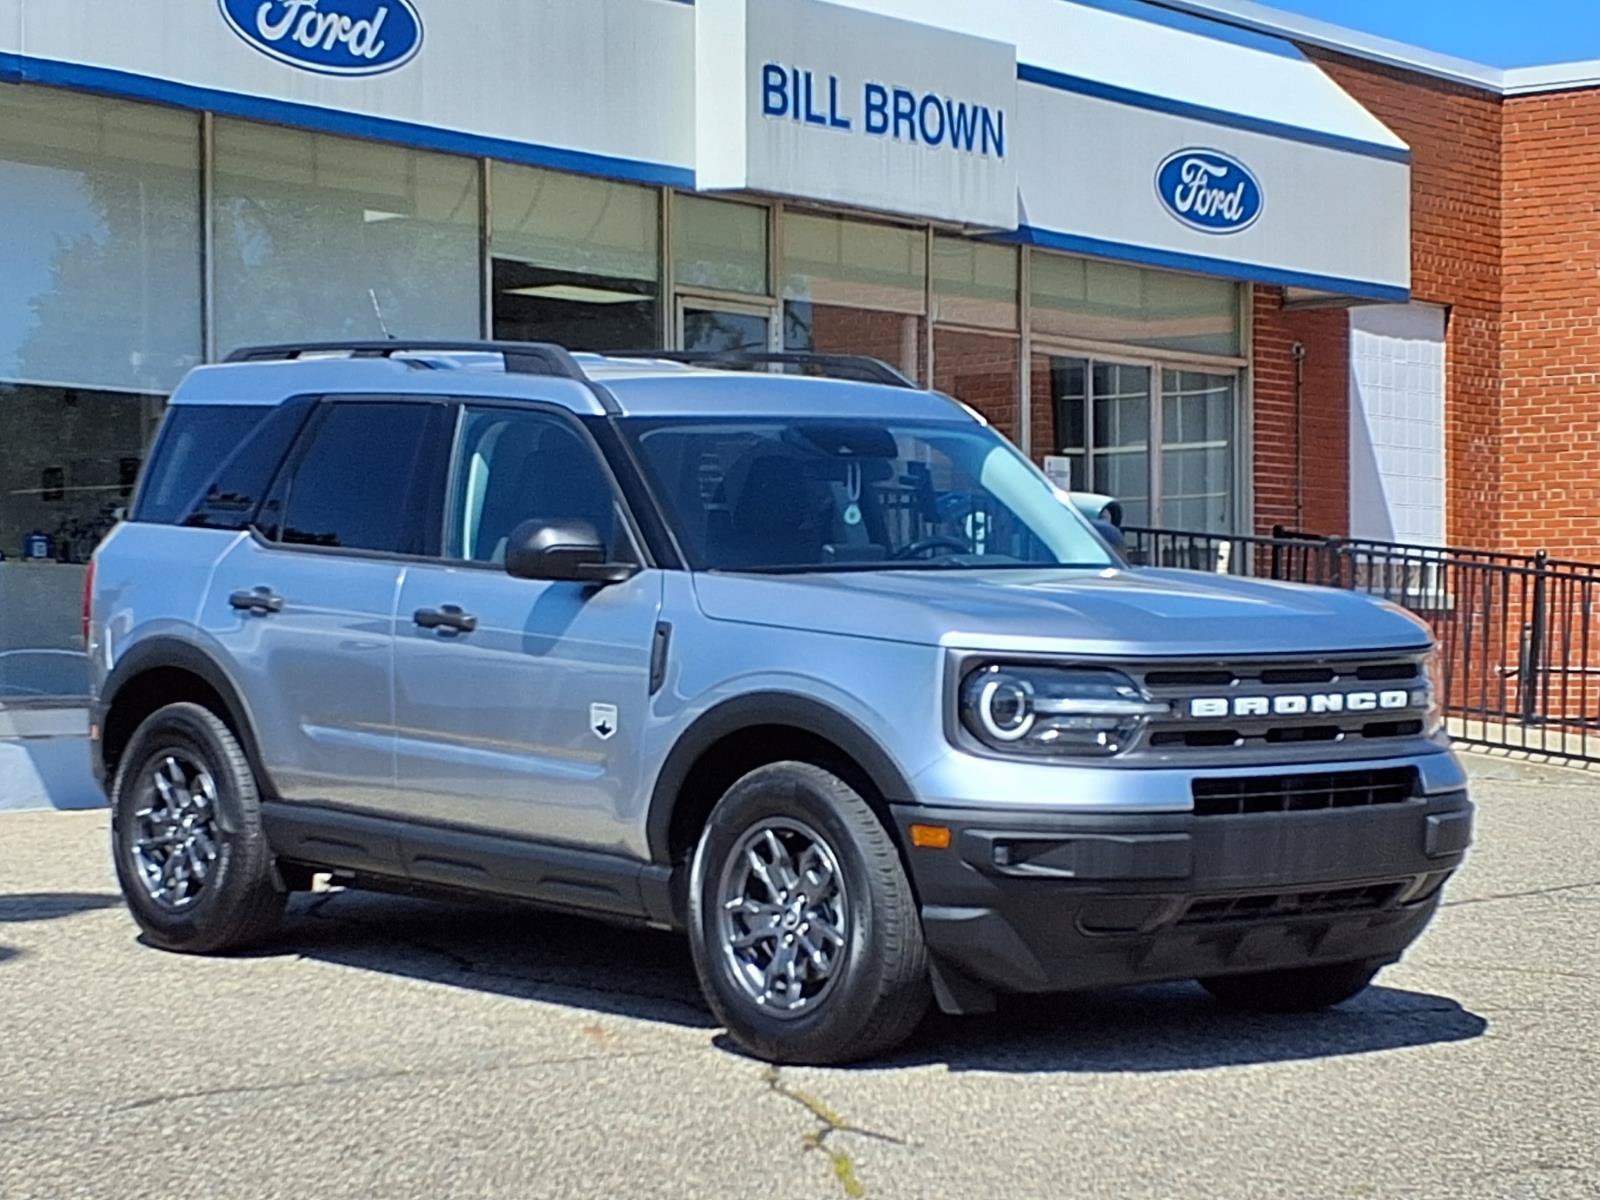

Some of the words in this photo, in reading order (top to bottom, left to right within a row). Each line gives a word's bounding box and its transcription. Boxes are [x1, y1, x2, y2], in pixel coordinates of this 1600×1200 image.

[762, 63, 851, 130] BILL
[864, 82, 1004, 158] BROWN
[1174, 158, 1245, 221] Ford
[1190, 690, 1408, 717] BRONCO
